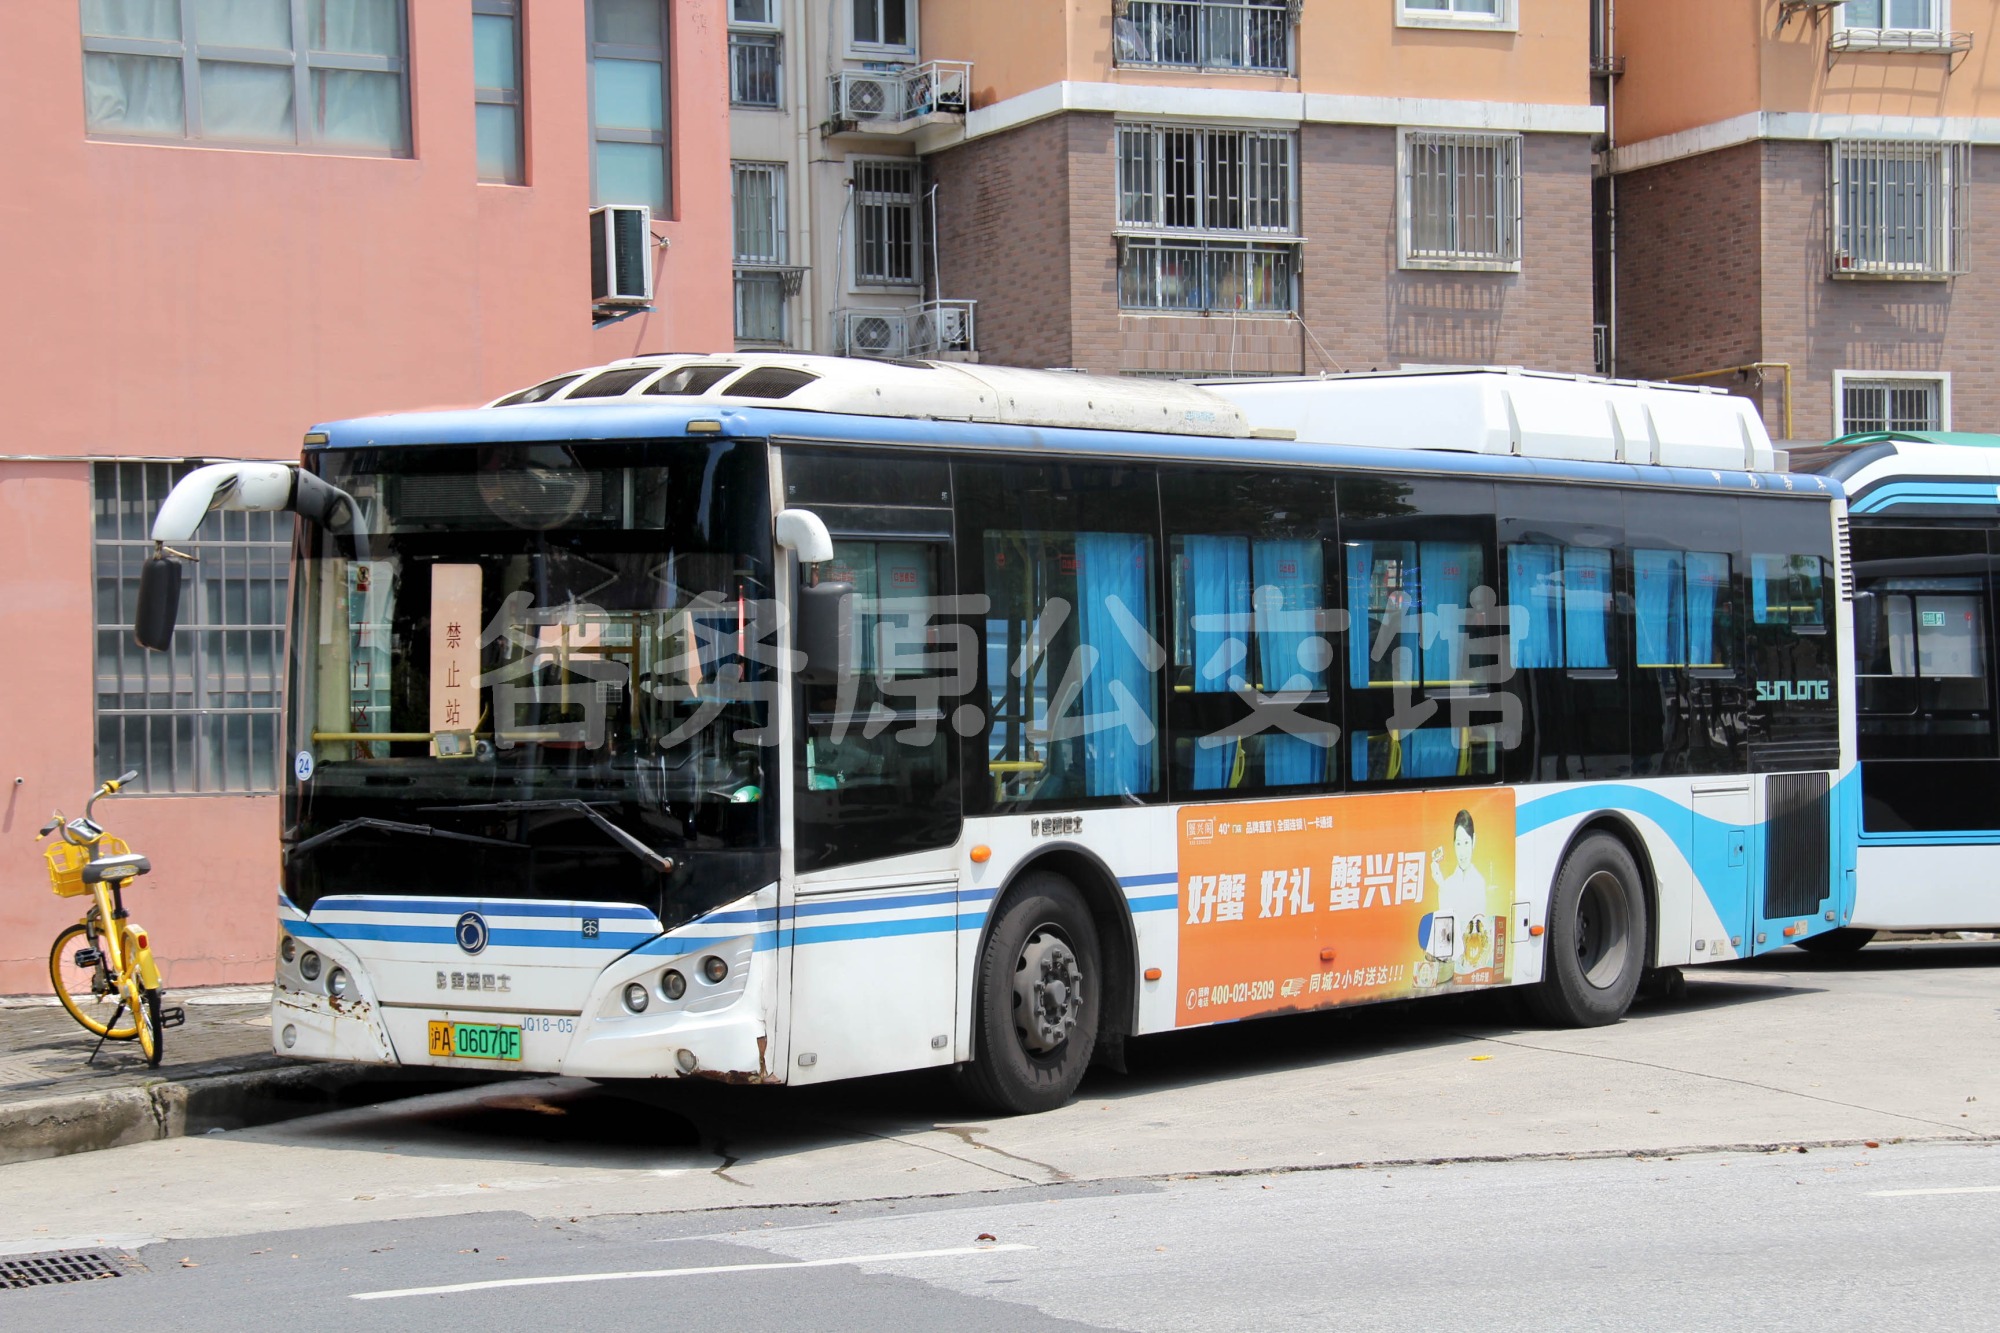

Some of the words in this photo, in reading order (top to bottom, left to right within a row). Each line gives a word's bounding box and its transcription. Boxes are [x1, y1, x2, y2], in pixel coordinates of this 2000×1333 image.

[1756, 680, 1829, 701] SUNLONG
[298, 757, 310, 774] 24
[1186, 873, 1246, 925] 好蟹
[1258, 867, 1315, 918] 好礼
[1329, 851, 1426, 911] 蟹兴阁
[1211, 979, 1275, 1005] 400-021-5209
[520, 1017, 573, 1033] JQ18-05
